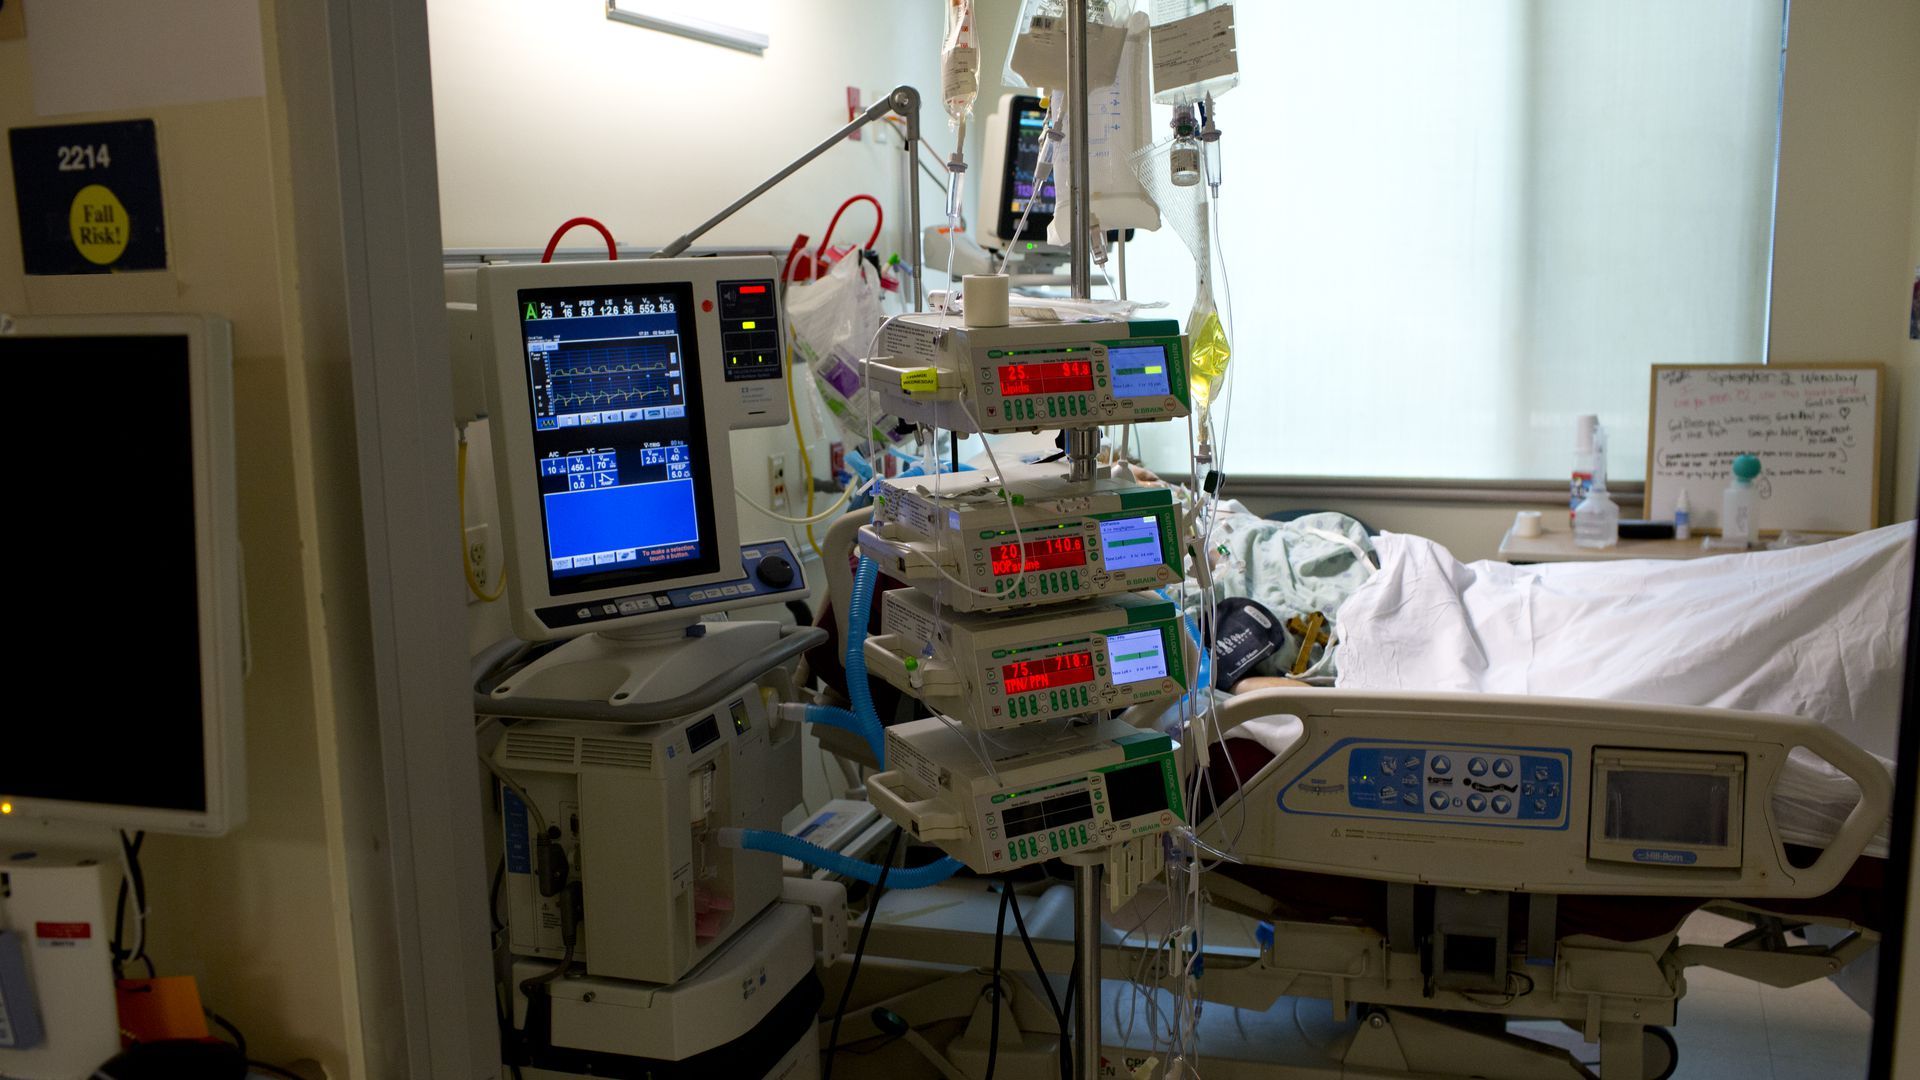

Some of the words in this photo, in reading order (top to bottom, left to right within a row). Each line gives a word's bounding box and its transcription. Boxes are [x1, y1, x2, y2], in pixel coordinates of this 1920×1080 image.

[58, 145, 111, 171] 2214
[83, 205, 115, 223] Fall
[80, 227, 121, 245] Risk!
[525, 303, 537, 320] A
[541, 309, 553, 319] 29
[562, 308, 573, 318] 16
[639, 303, 656, 314] 552
[1001, 381, 1030, 395] Lipids
[597, 461, 607, 469] 70
[646, 456, 657, 464] 2.0
[573, 481, 585, 490] 0.0
[651, 547, 665, 555] make
[671, 545, 696, 553] selection,
[649, 554, 664, 562] touch
